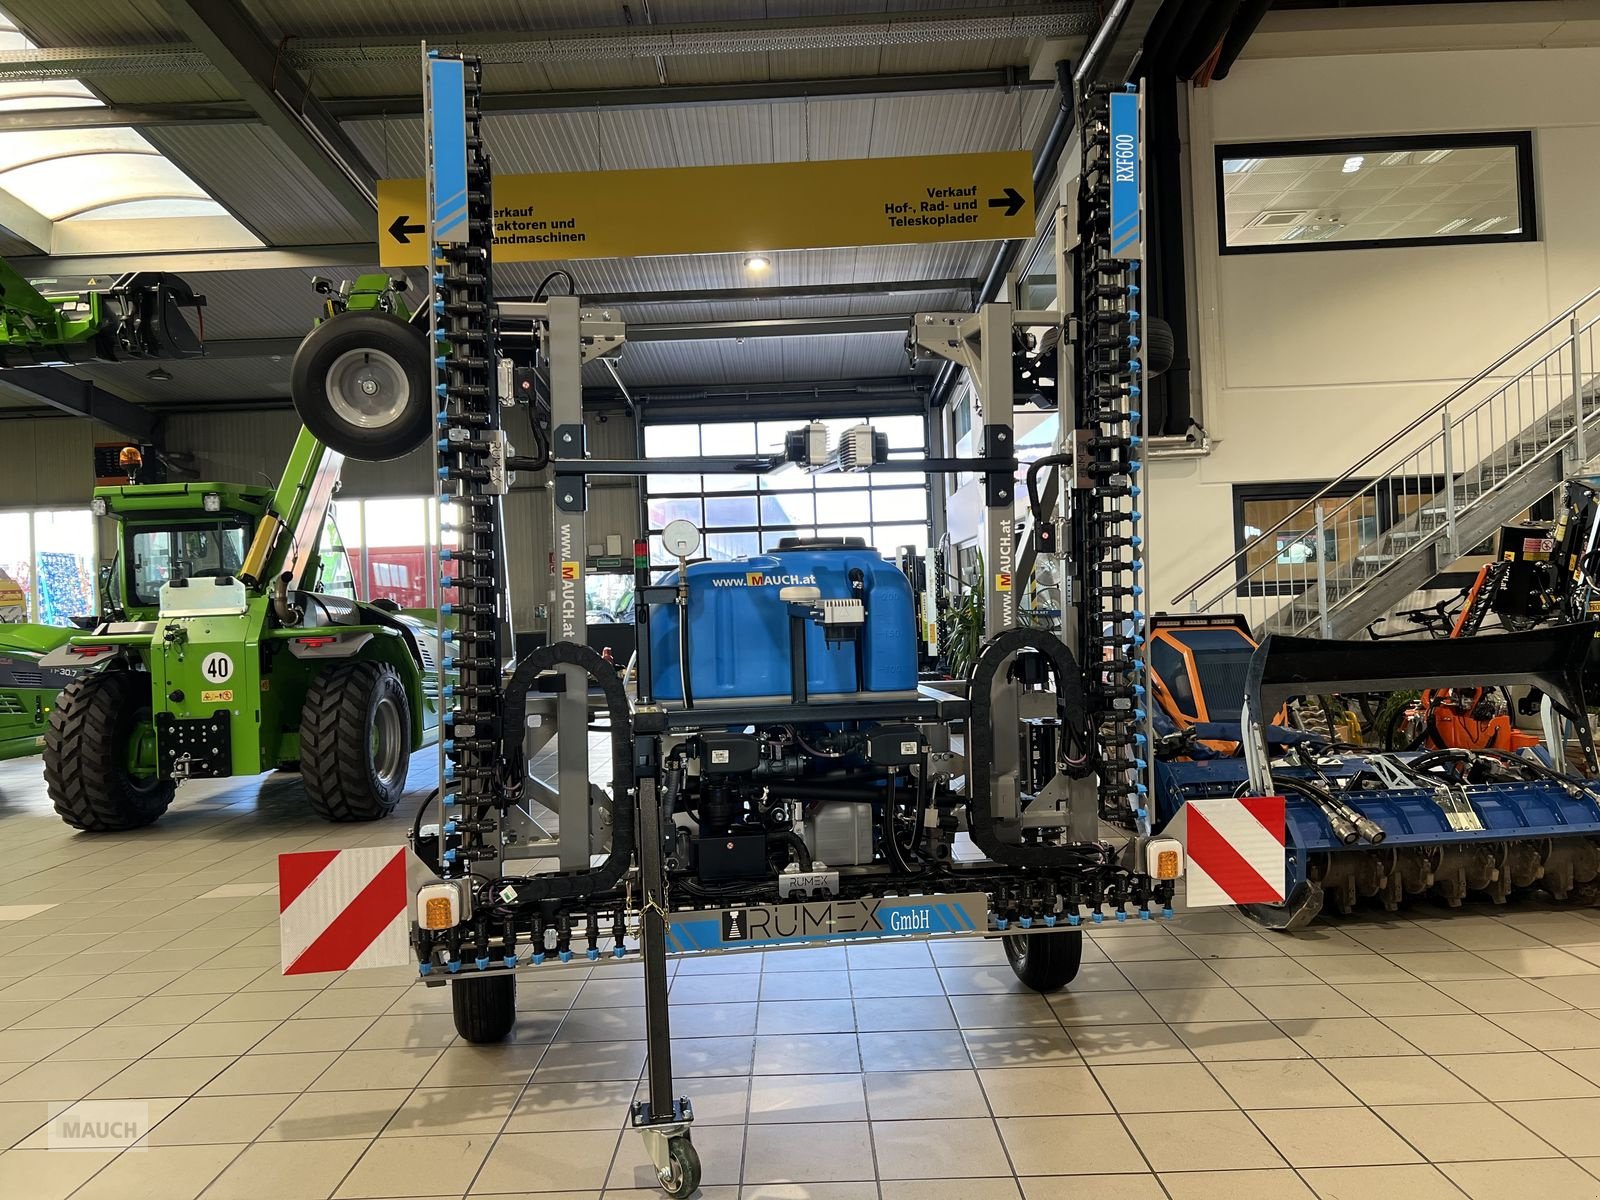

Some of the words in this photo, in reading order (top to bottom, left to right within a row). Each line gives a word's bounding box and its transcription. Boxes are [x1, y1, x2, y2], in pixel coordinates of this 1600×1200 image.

[1116, 134, 1134, 183] RXF600
[927, 186, 977, 198] Verkauf
[494, 206, 534, 218] erkauf
[885, 203, 917, 214] Hof-,
[921, 201, 950, 212] Rad-
[953, 199, 978, 210] und
[494, 220, 547, 231] aktoren
[551, 218, 575, 229] und
[889, 213, 979, 227] Teleskoplader
[492, 232, 586, 245] andmaschinen
[1000, 520, 1012, 626] www.MAUCH.at
[561, 524, 575, 638] www.MAUCH.at
[712, 574, 816, 587] www.MAUCH.at
[208, 658, 228, 677] 40
[790, 876, 827, 887] RUMEX
[750, 900, 883, 939] RUMEX
[890, 910, 930, 930] GmbH
